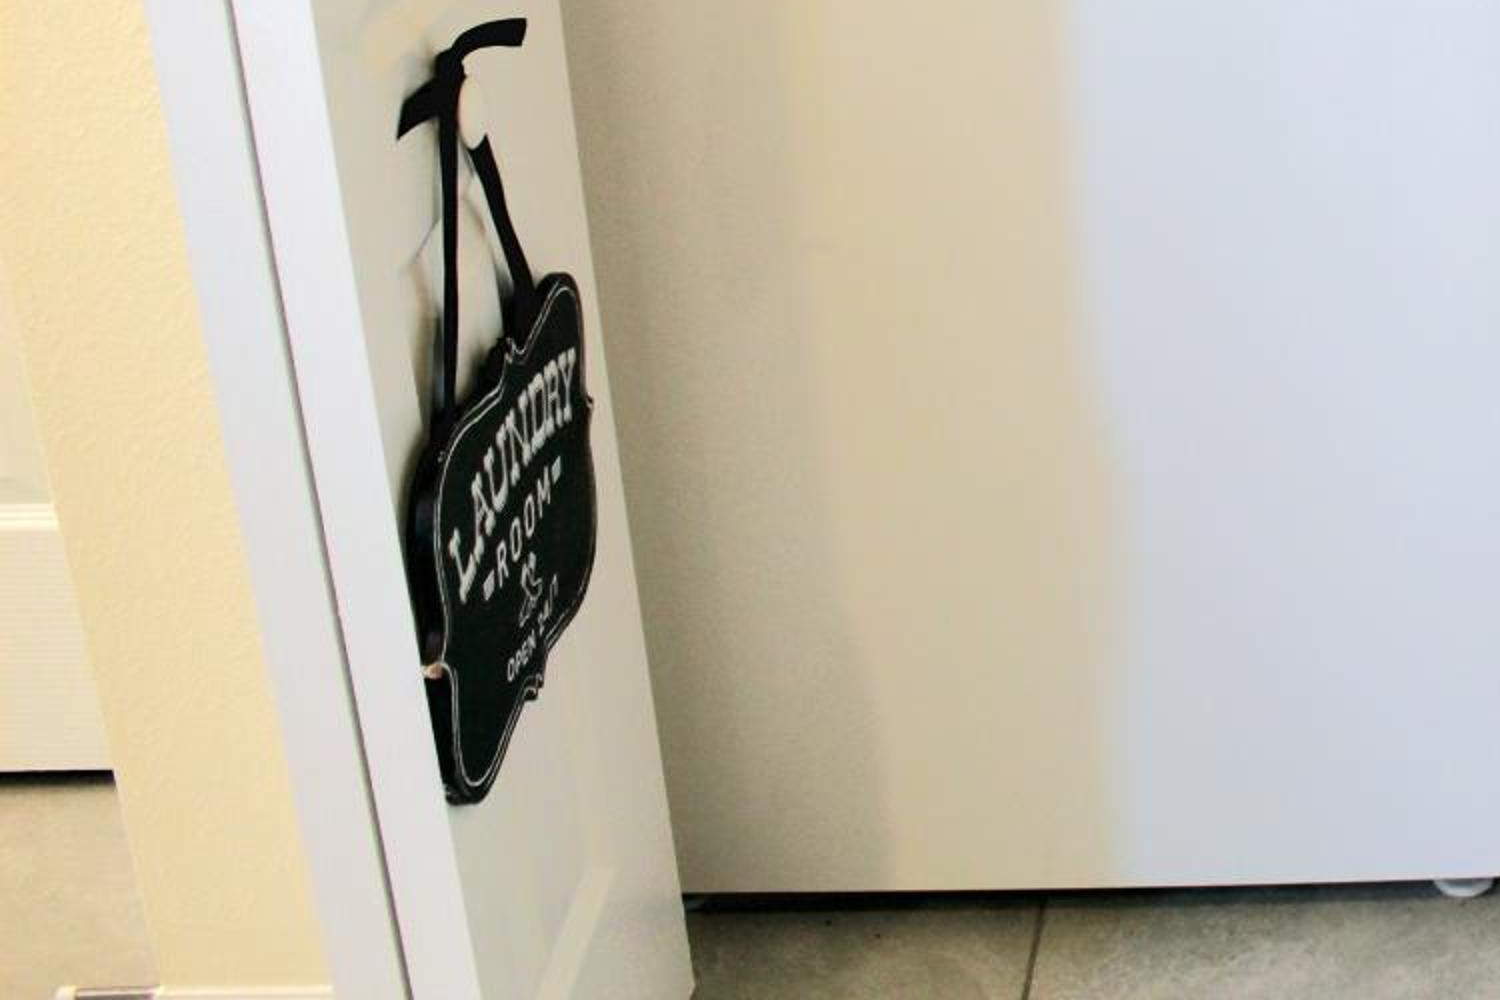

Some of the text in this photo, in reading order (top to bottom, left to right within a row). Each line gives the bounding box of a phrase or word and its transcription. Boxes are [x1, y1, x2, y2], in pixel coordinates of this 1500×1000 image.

[448, 349, 576, 603] LAUNDRY
[496, 465, 551, 588] ROOM
[507, 629, 537, 683] OPEN
